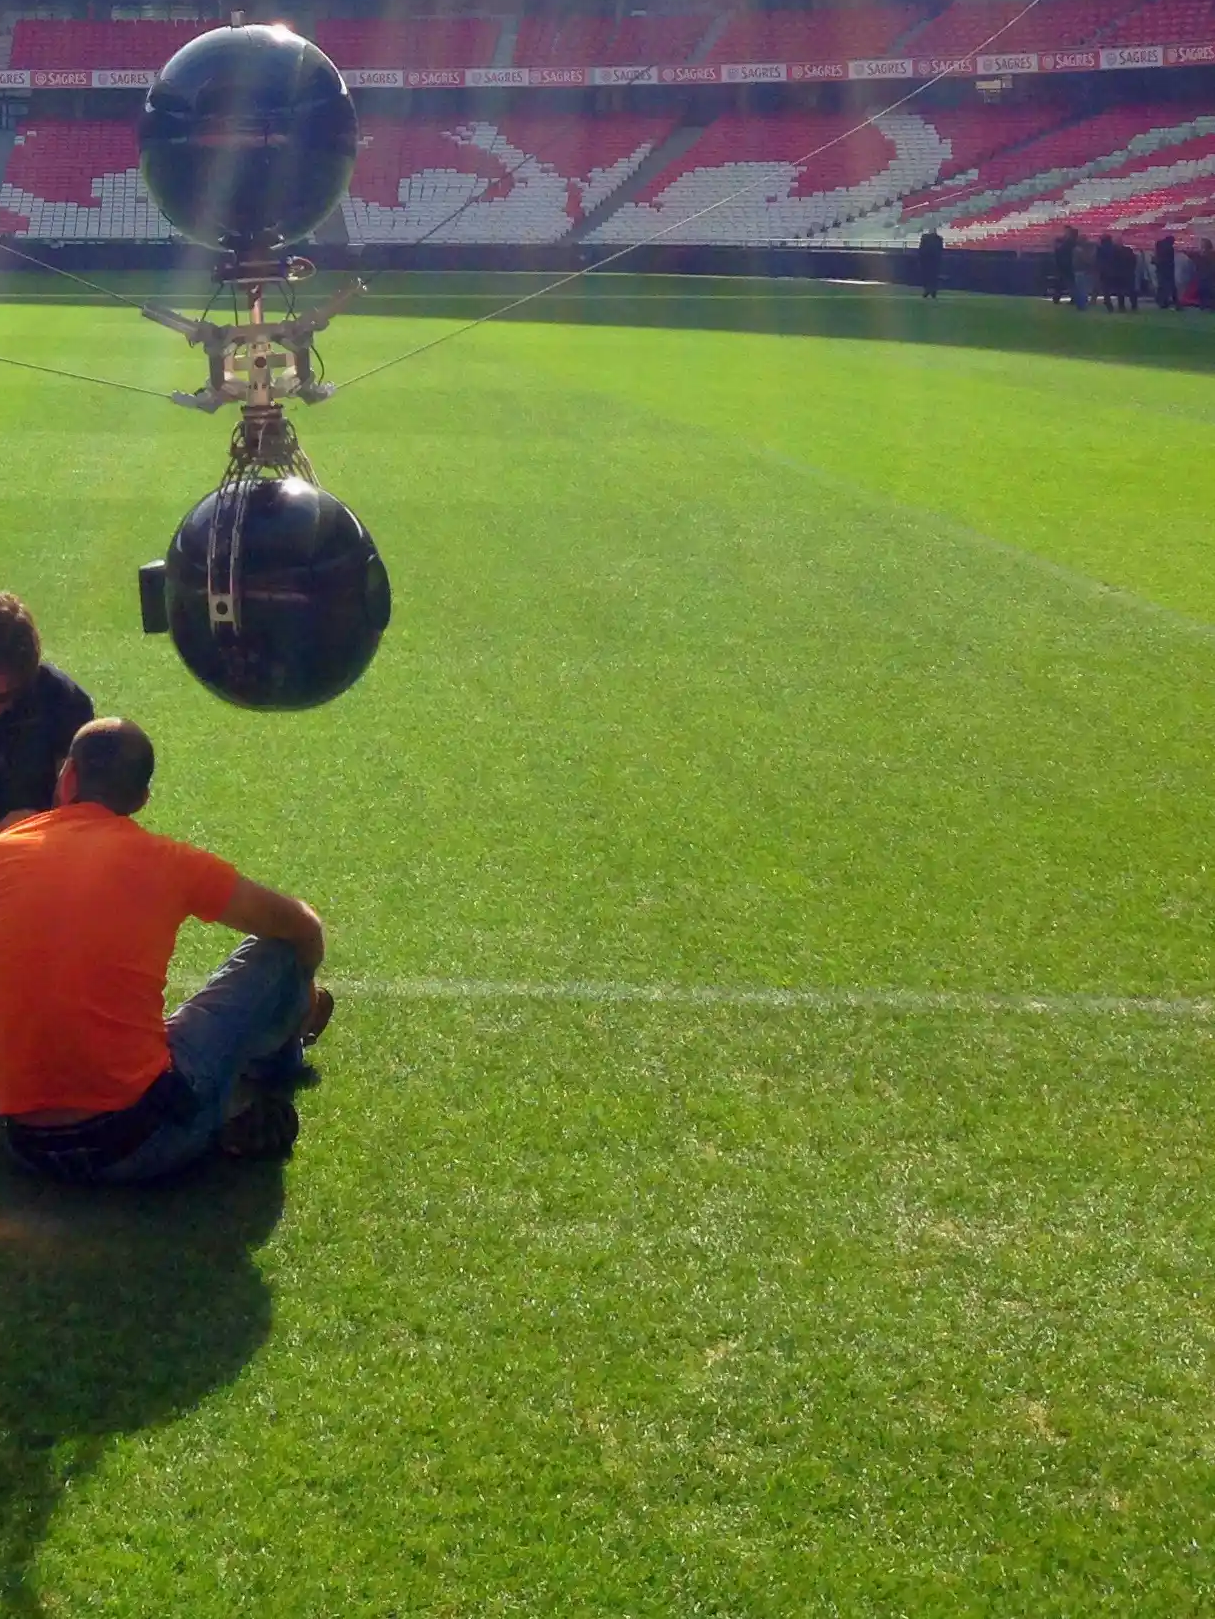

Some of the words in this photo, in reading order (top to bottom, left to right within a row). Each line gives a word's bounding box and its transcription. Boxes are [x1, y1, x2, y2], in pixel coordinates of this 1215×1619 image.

[47, 71, 86, 85] SAGRES
[110, 71, 149, 85] SAGRES
[359, 70, 398, 84] SAGRES
[421, 70, 460, 84] SAGRES
[483, 70, 523, 83] SAGRES
[543, 69, 582, 82] SAGRES
[676, 66, 716, 80] SAGRES
[741, 65, 781, 79] SAGRES
[803, 64, 842, 78] SAGRES
[866, 60, 907, 75] SAGRES
[994, 56, 1032, 70] SAGRES
[1055, 52, 1094, 67] SAGRES
[1119, 49, 1159, 63] SAGRES
